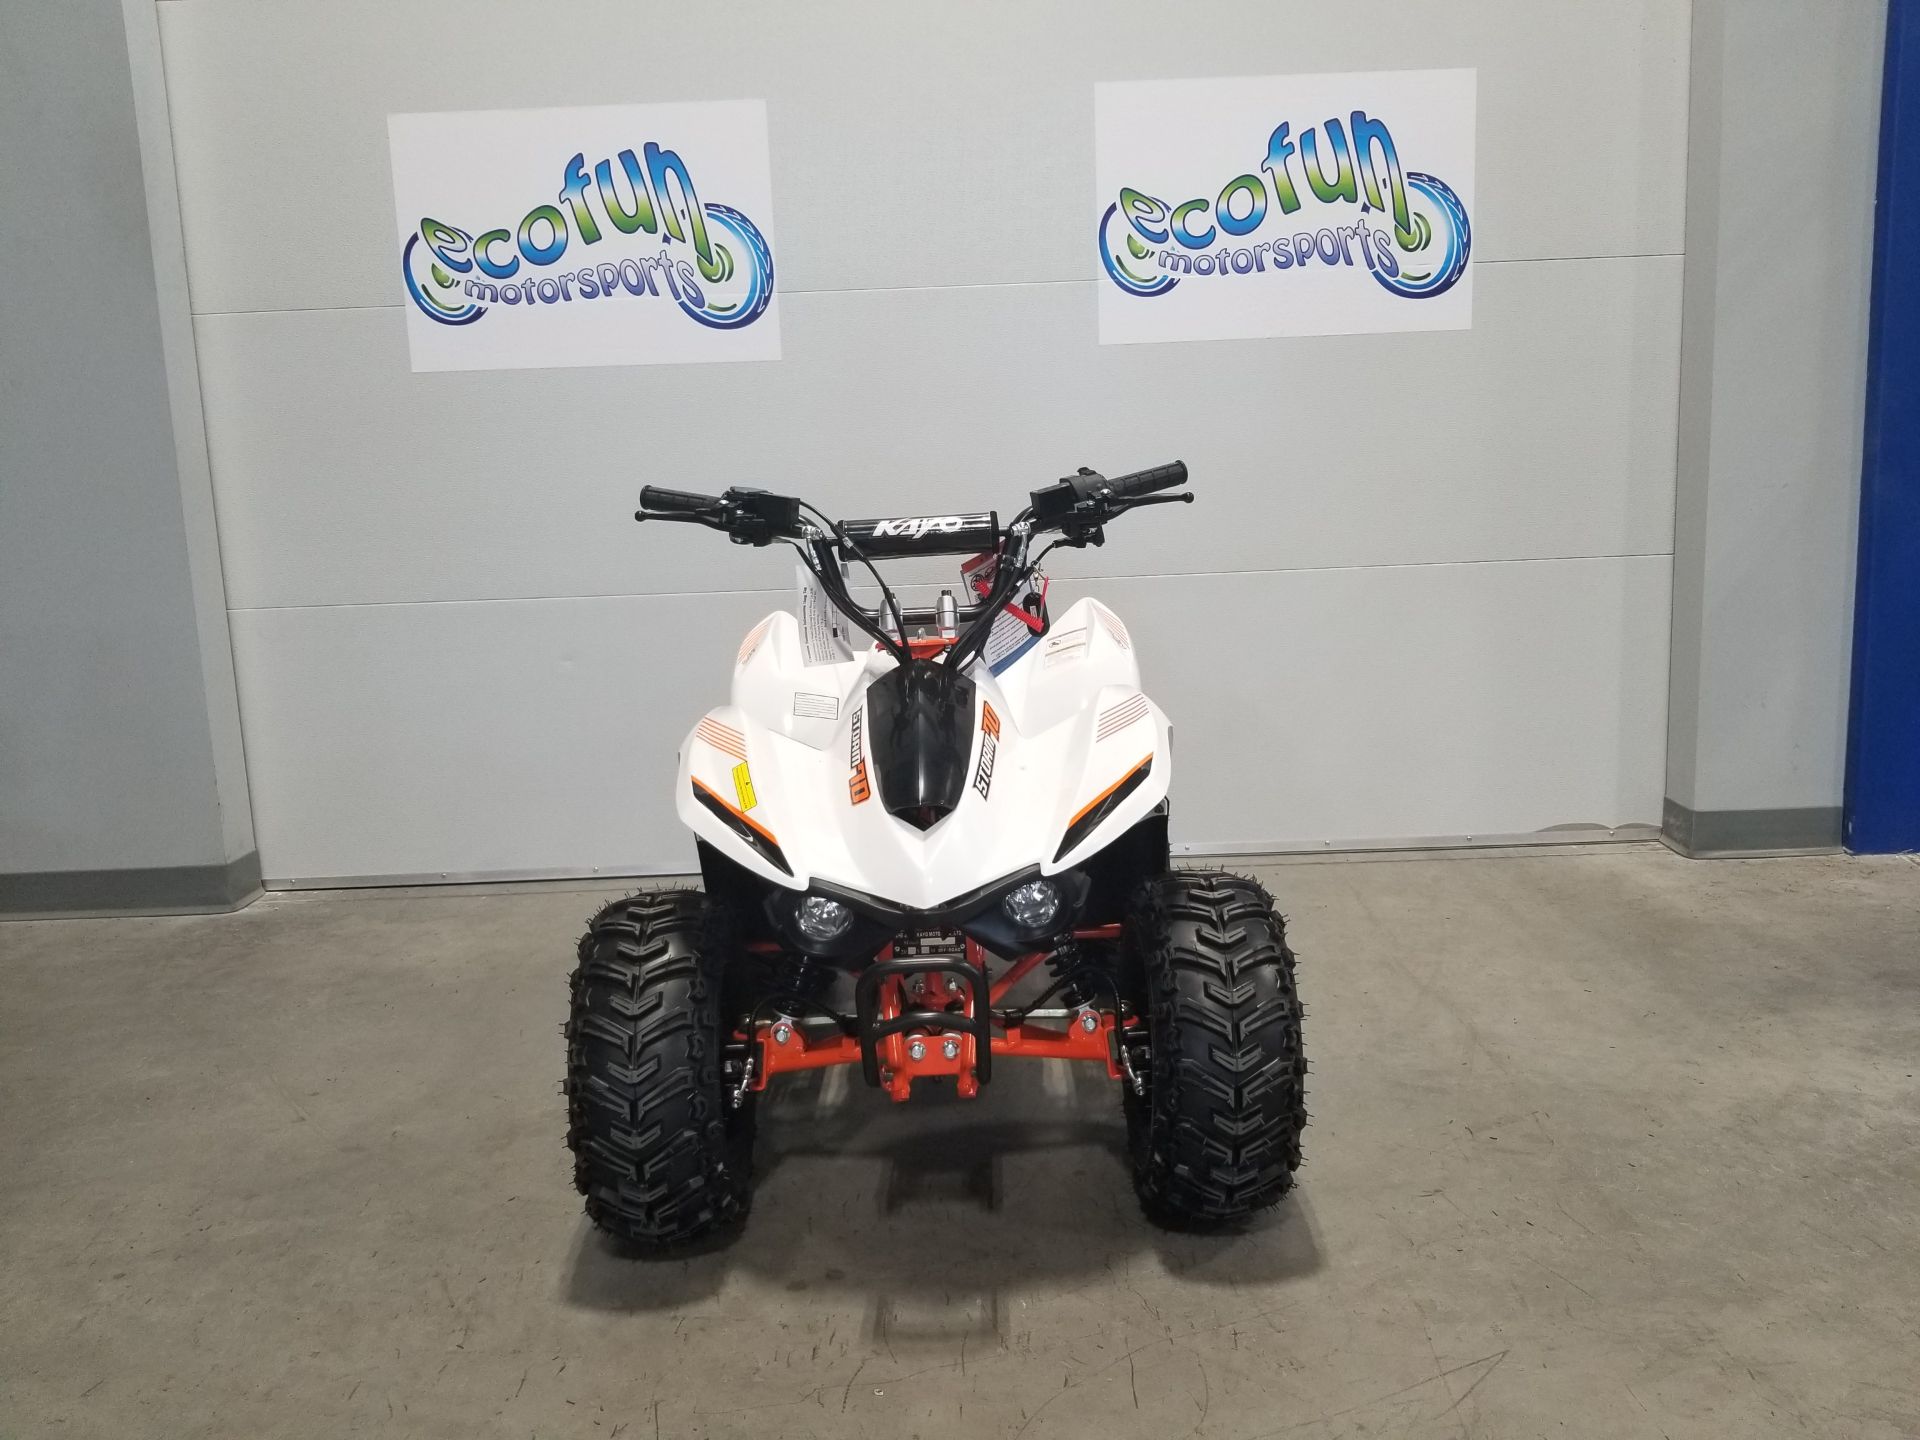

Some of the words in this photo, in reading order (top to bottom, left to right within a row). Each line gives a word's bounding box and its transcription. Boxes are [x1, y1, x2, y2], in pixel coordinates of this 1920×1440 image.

[420, 141, 714, 266] ecofun
[1119, 110, 1412, 235] ecofun
[464, 249, 706, 309] motorsports
[1158, 218, 1400, 279] motorsports
